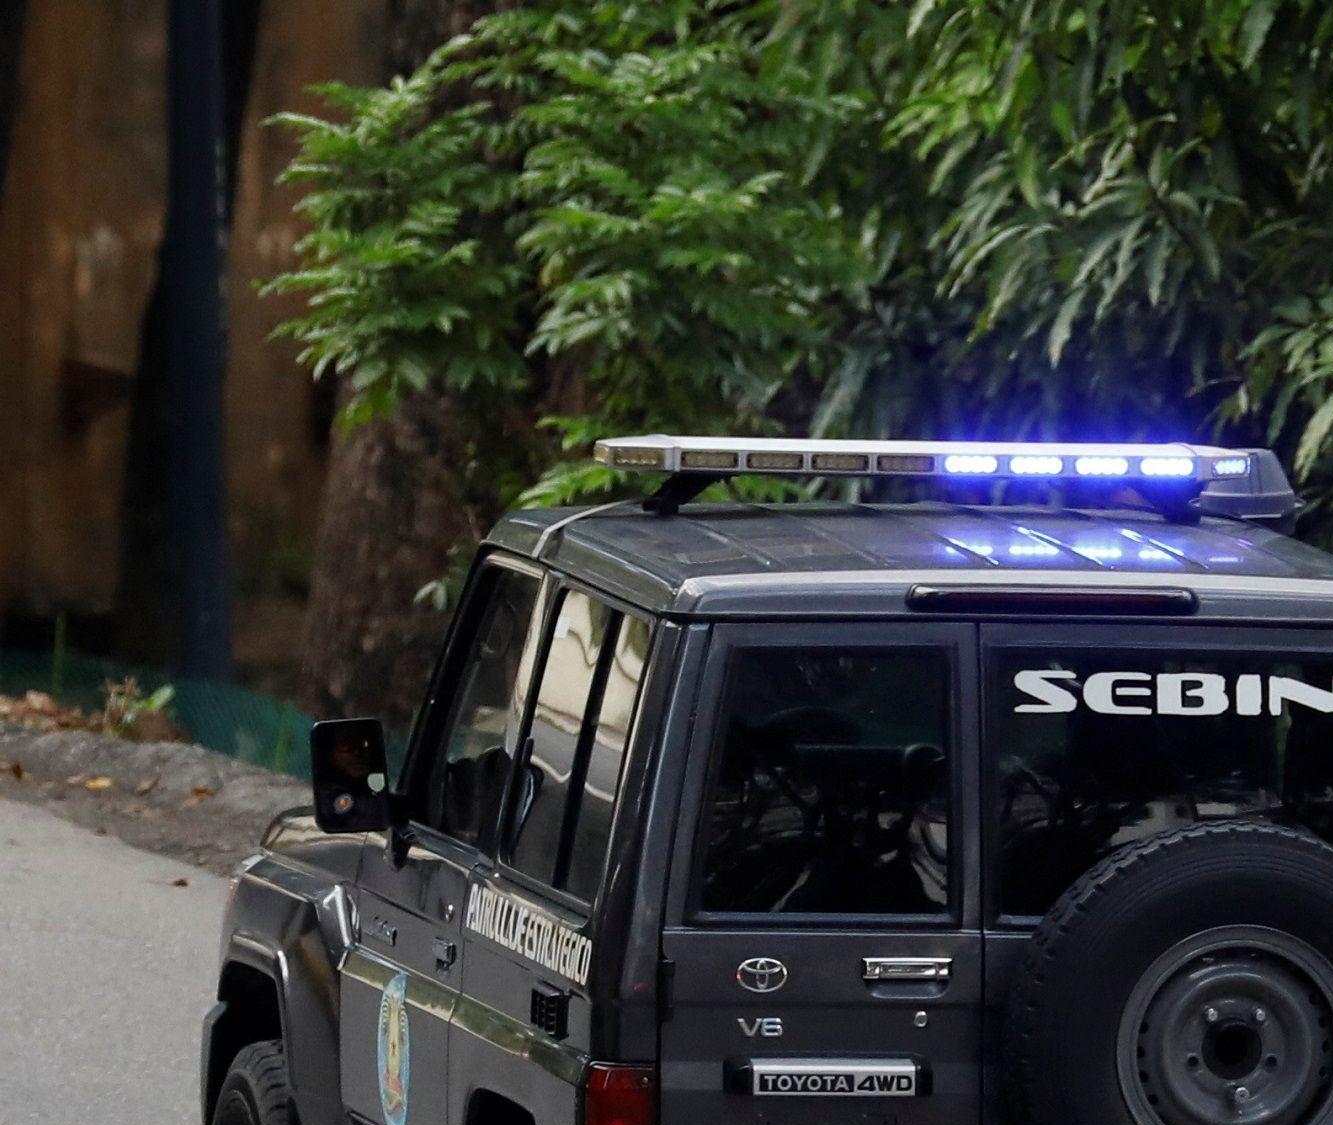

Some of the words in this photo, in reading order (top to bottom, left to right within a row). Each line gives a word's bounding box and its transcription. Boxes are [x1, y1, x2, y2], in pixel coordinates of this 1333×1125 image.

[737, 1017, 783, 1037] V6
[764, 1075, 850, 1091] TOYOTA
[857, 1075, 913, 1092] 4WD
